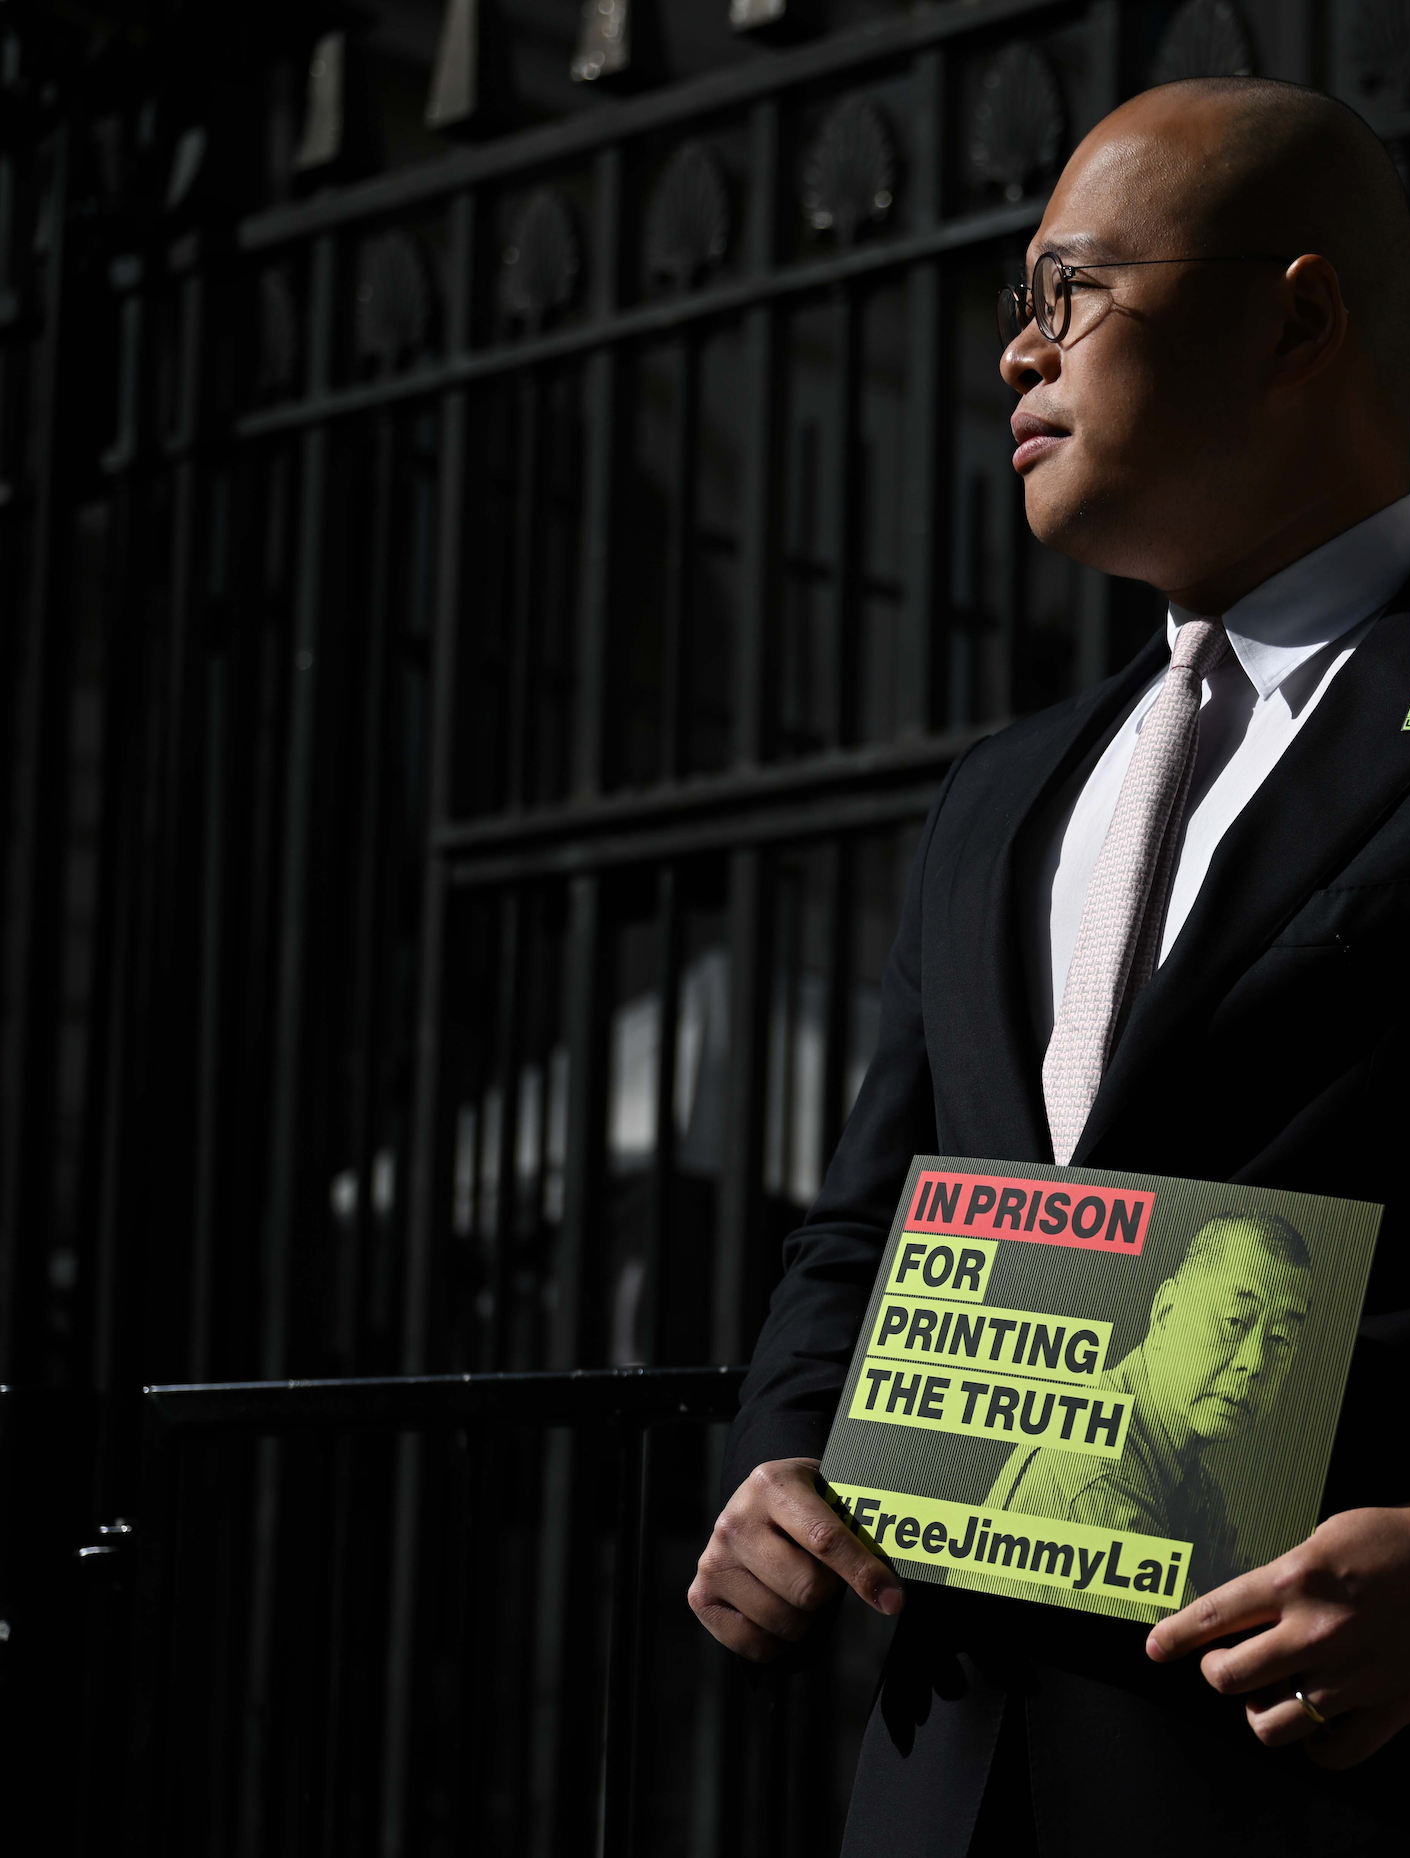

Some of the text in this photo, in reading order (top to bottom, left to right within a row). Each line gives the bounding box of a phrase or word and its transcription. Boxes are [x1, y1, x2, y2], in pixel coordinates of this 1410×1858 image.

[913, 1181, 1145, 1244] IN PRISON
[895, 1243, 987, 1292] FOR
[876, 1305, 1100, 1375] PRINTING
[864, 1368, 1125, 1448] THE TRUTH
